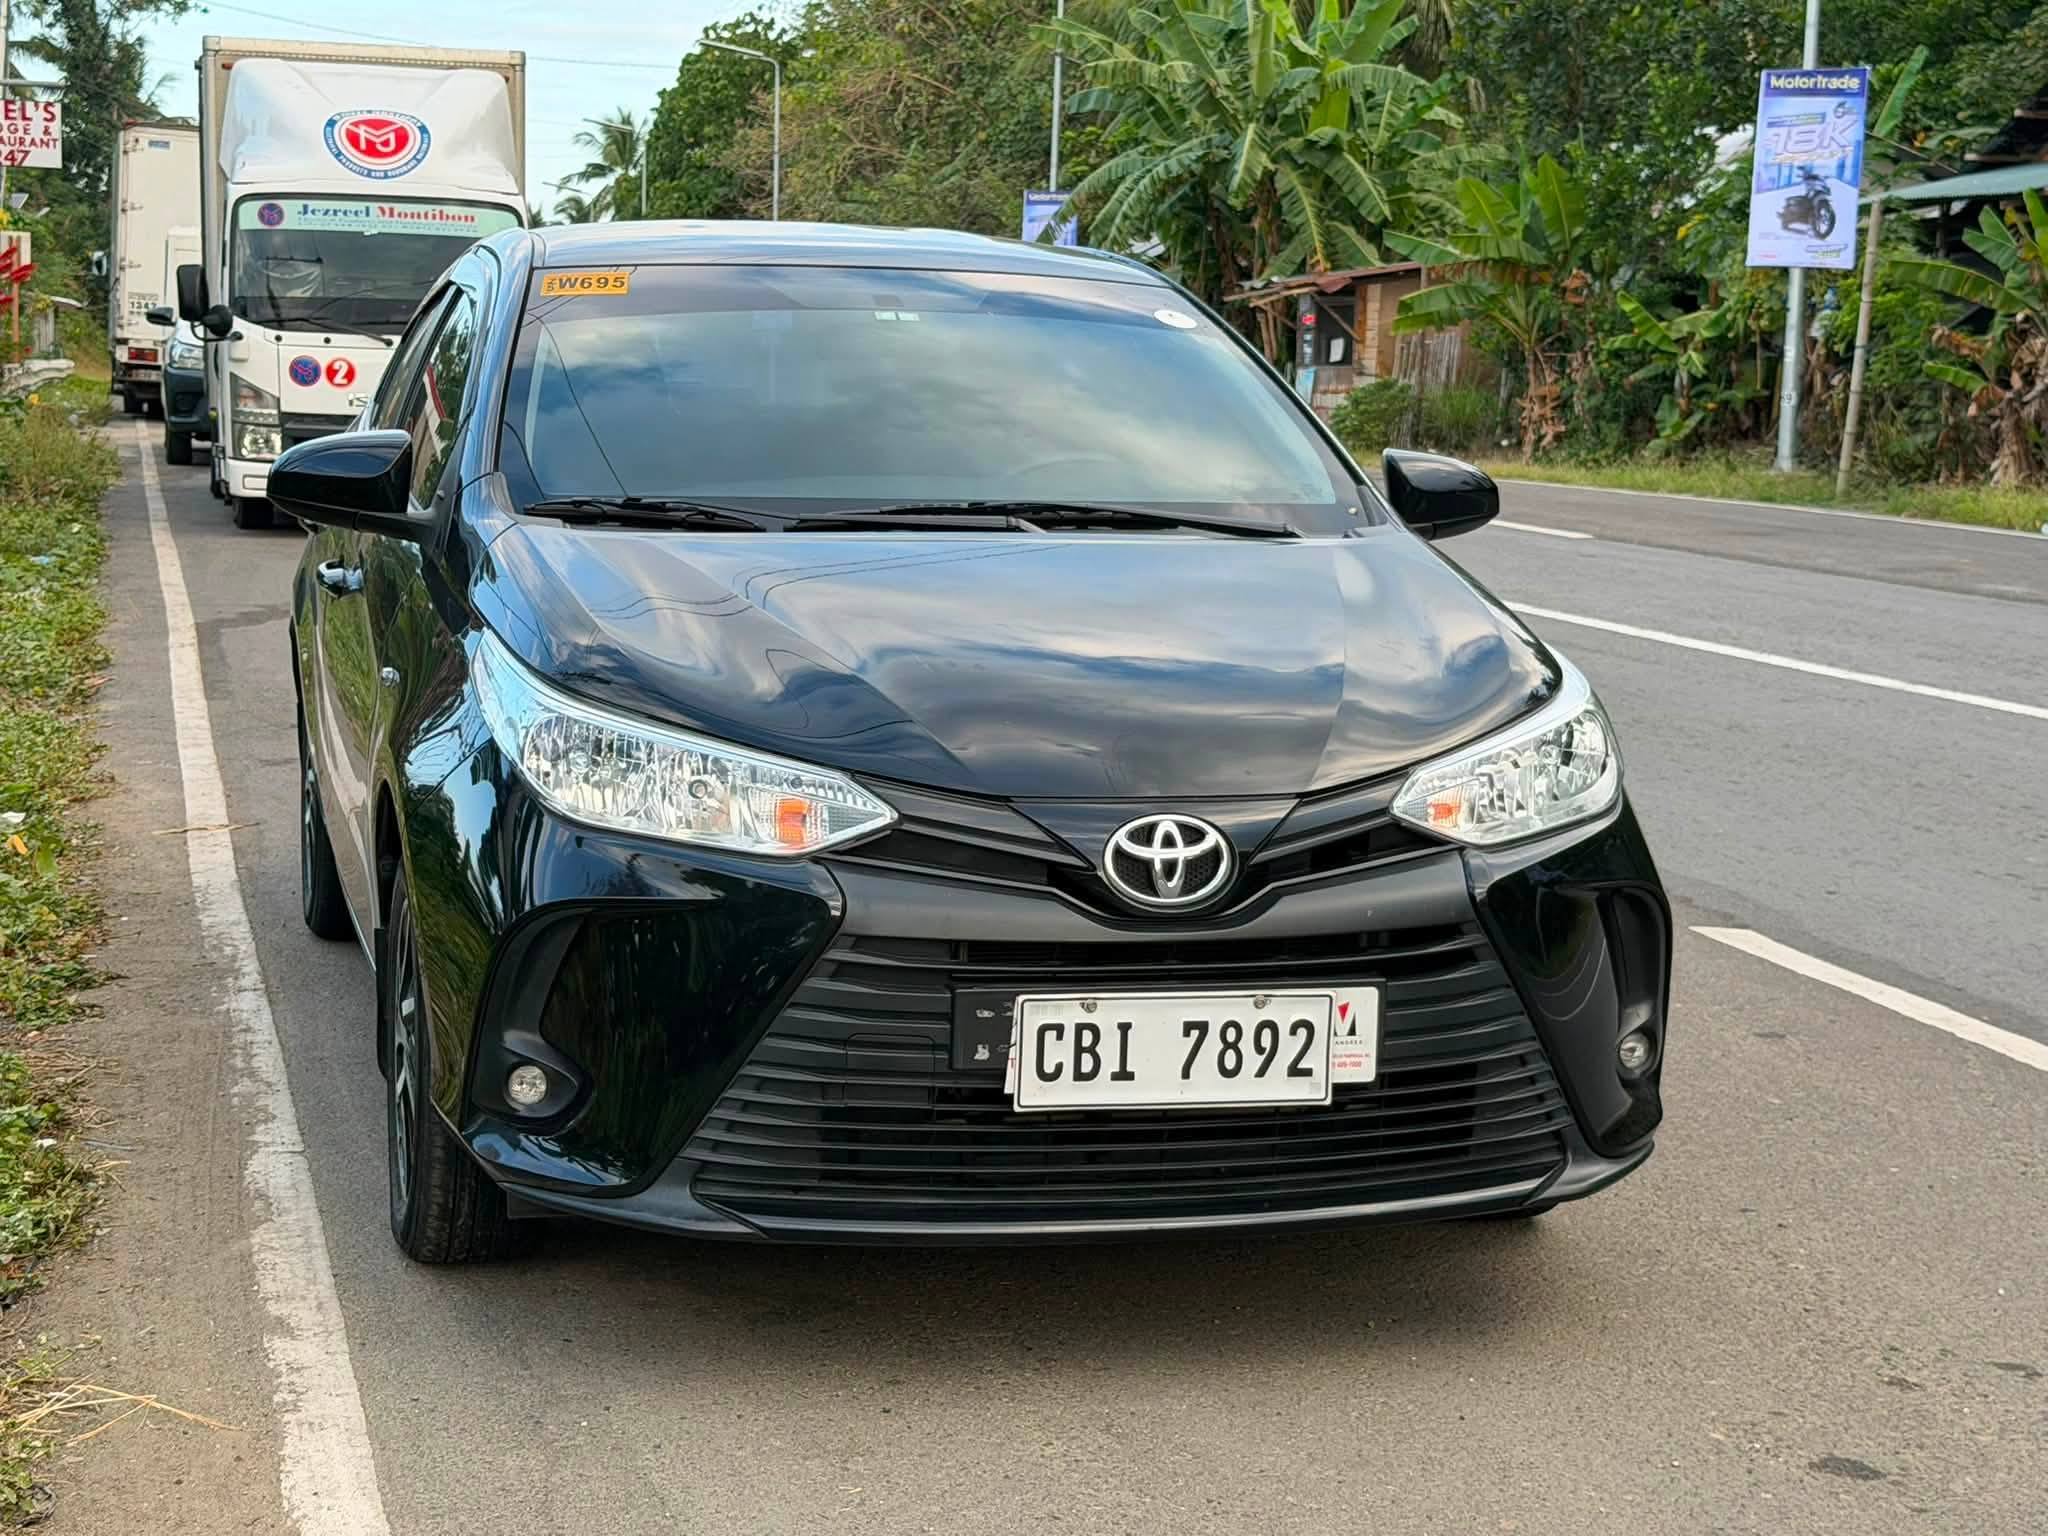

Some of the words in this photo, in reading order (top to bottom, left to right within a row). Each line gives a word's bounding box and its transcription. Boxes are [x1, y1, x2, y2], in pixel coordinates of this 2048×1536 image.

[0, 123, 31, 135] GE
[0, 149, 31, 166] 47
[297, 204, 370, 218] Jezreel
[377, 206, 475, 223] Montibon
[559, 276, 625, 290] W695
[332, 360, 350, 385] 2
[1035, 1021, 1135, 1083] CBI
[1180, 1018, 1317, 1081] 7892
